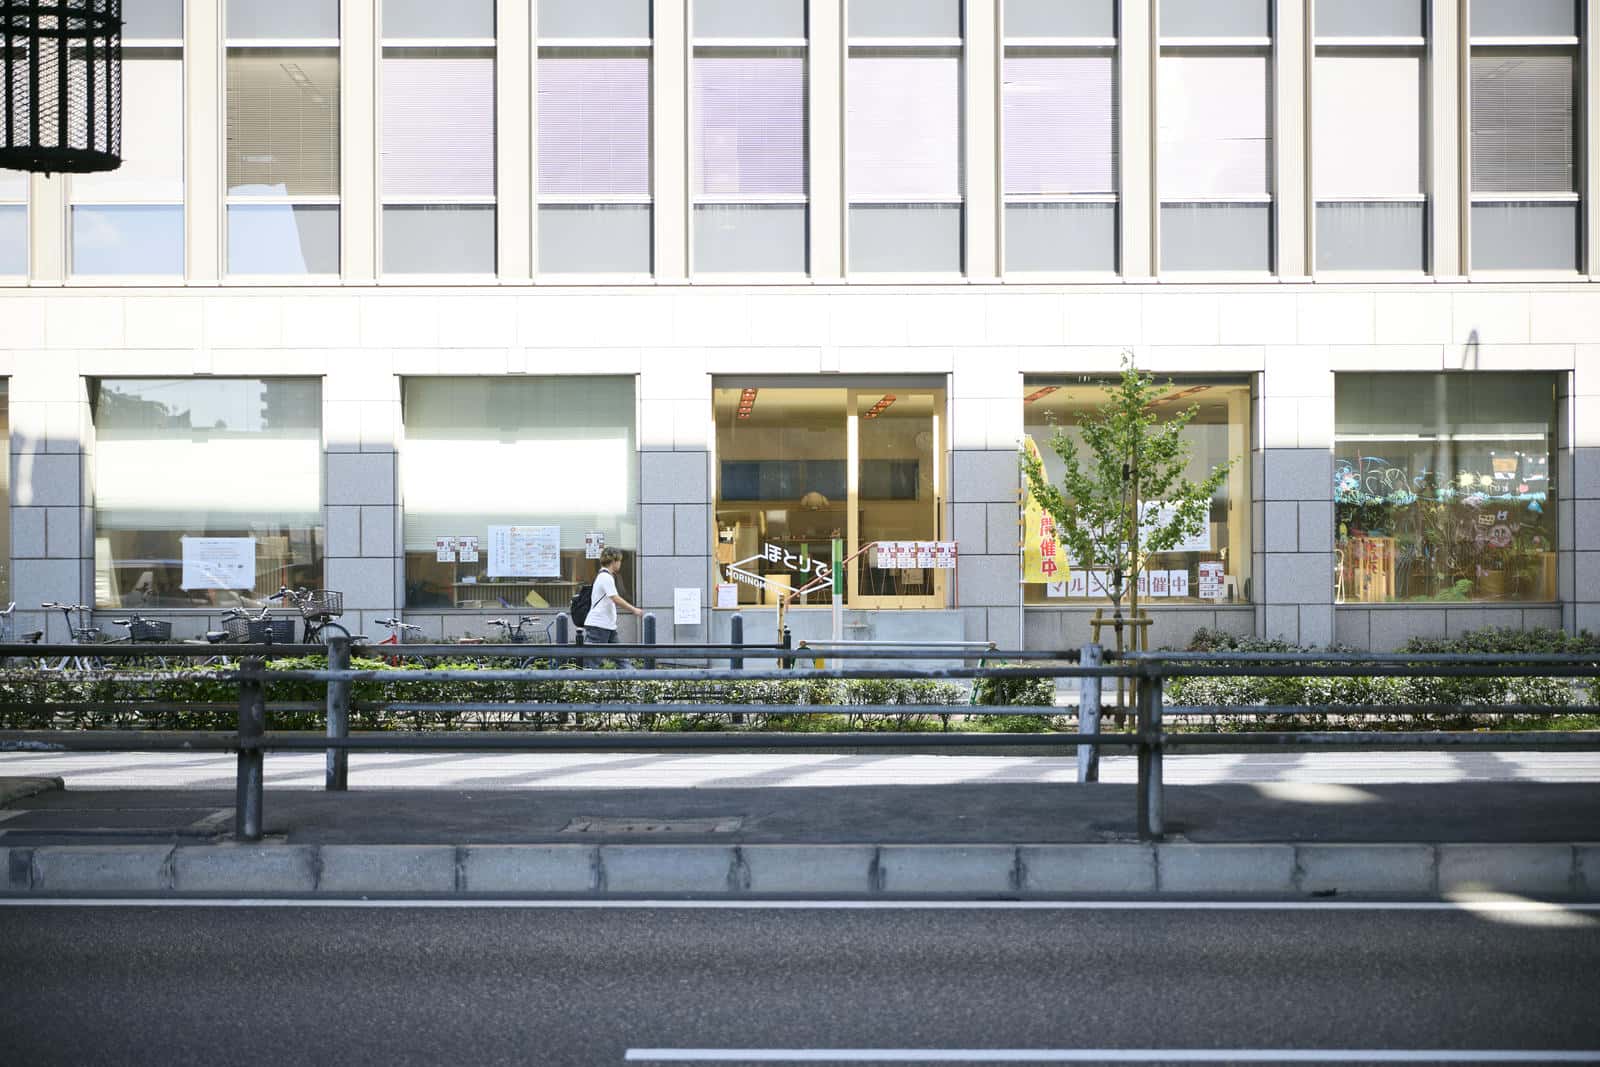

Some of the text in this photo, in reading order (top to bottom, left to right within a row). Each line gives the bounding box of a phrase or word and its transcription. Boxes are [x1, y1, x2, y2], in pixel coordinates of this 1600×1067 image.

[1040, 508, 1057, 577] 開催中
[726, 569, 780, 594] MORINOM
[1053, 576, 1186, 592] マルシ開催中
